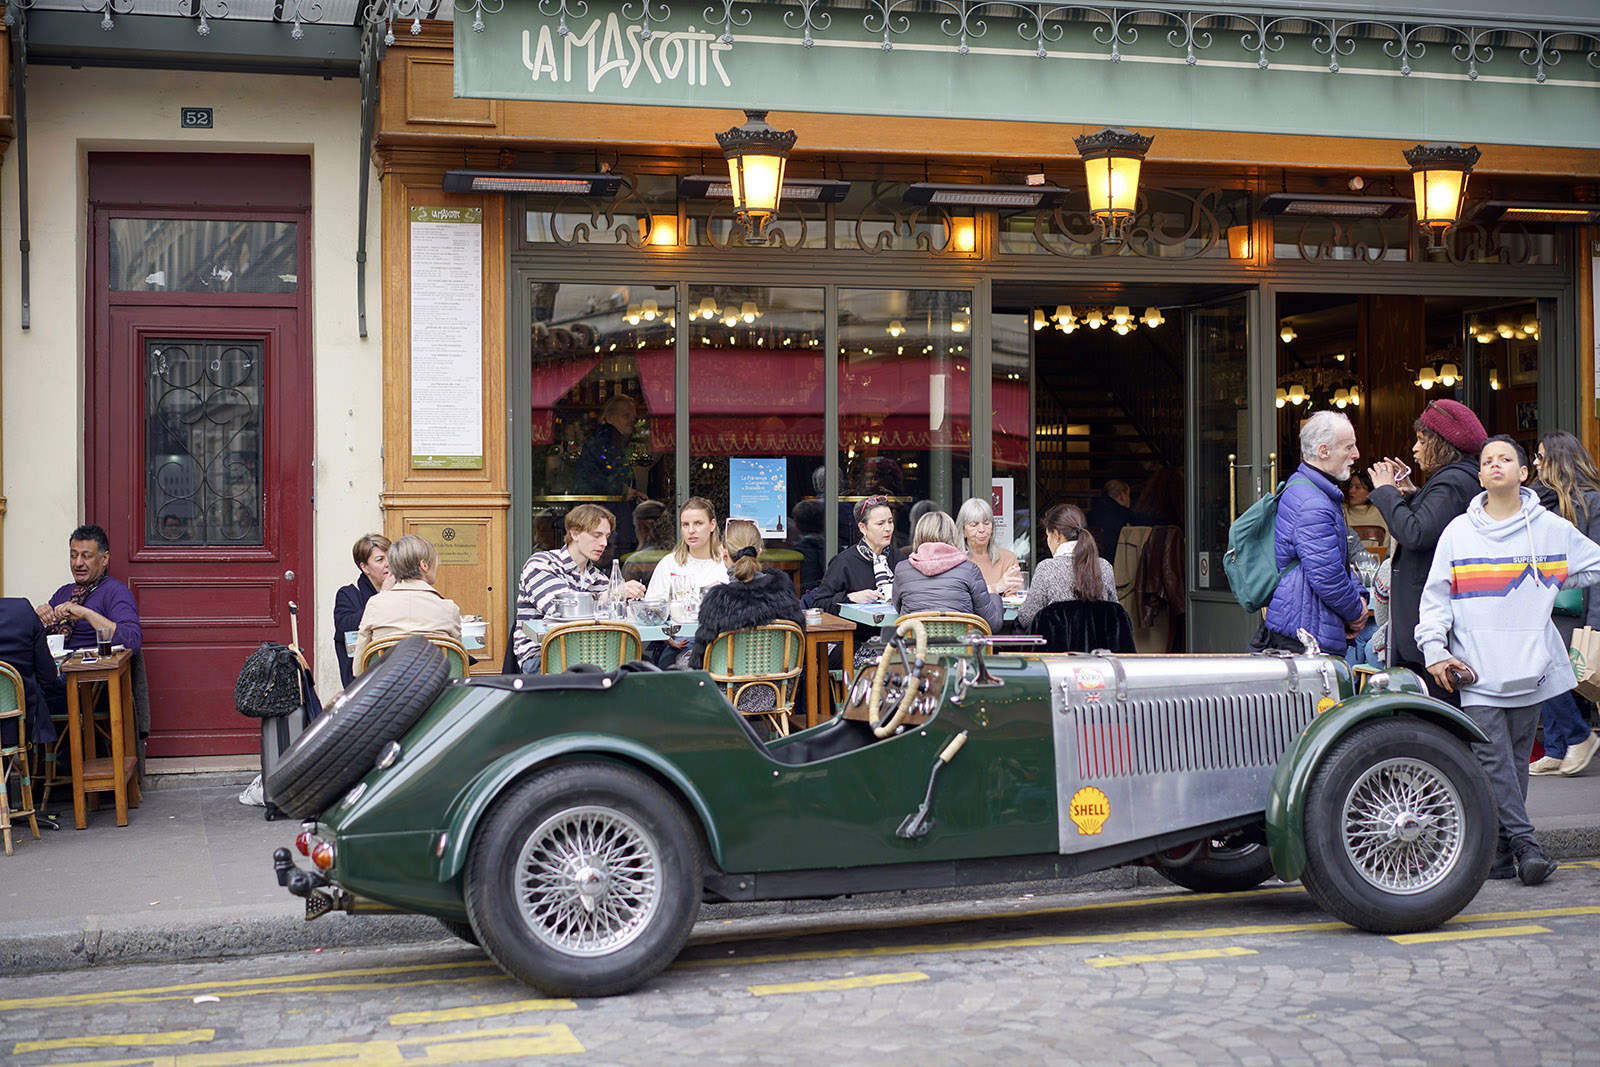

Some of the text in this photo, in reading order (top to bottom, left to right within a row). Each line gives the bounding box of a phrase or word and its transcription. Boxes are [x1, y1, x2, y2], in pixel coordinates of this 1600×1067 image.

[521, 24, 558, 82] LA
[186, 111, 208, 125] 52
[1074, 803, 1105, 816] SHELL
